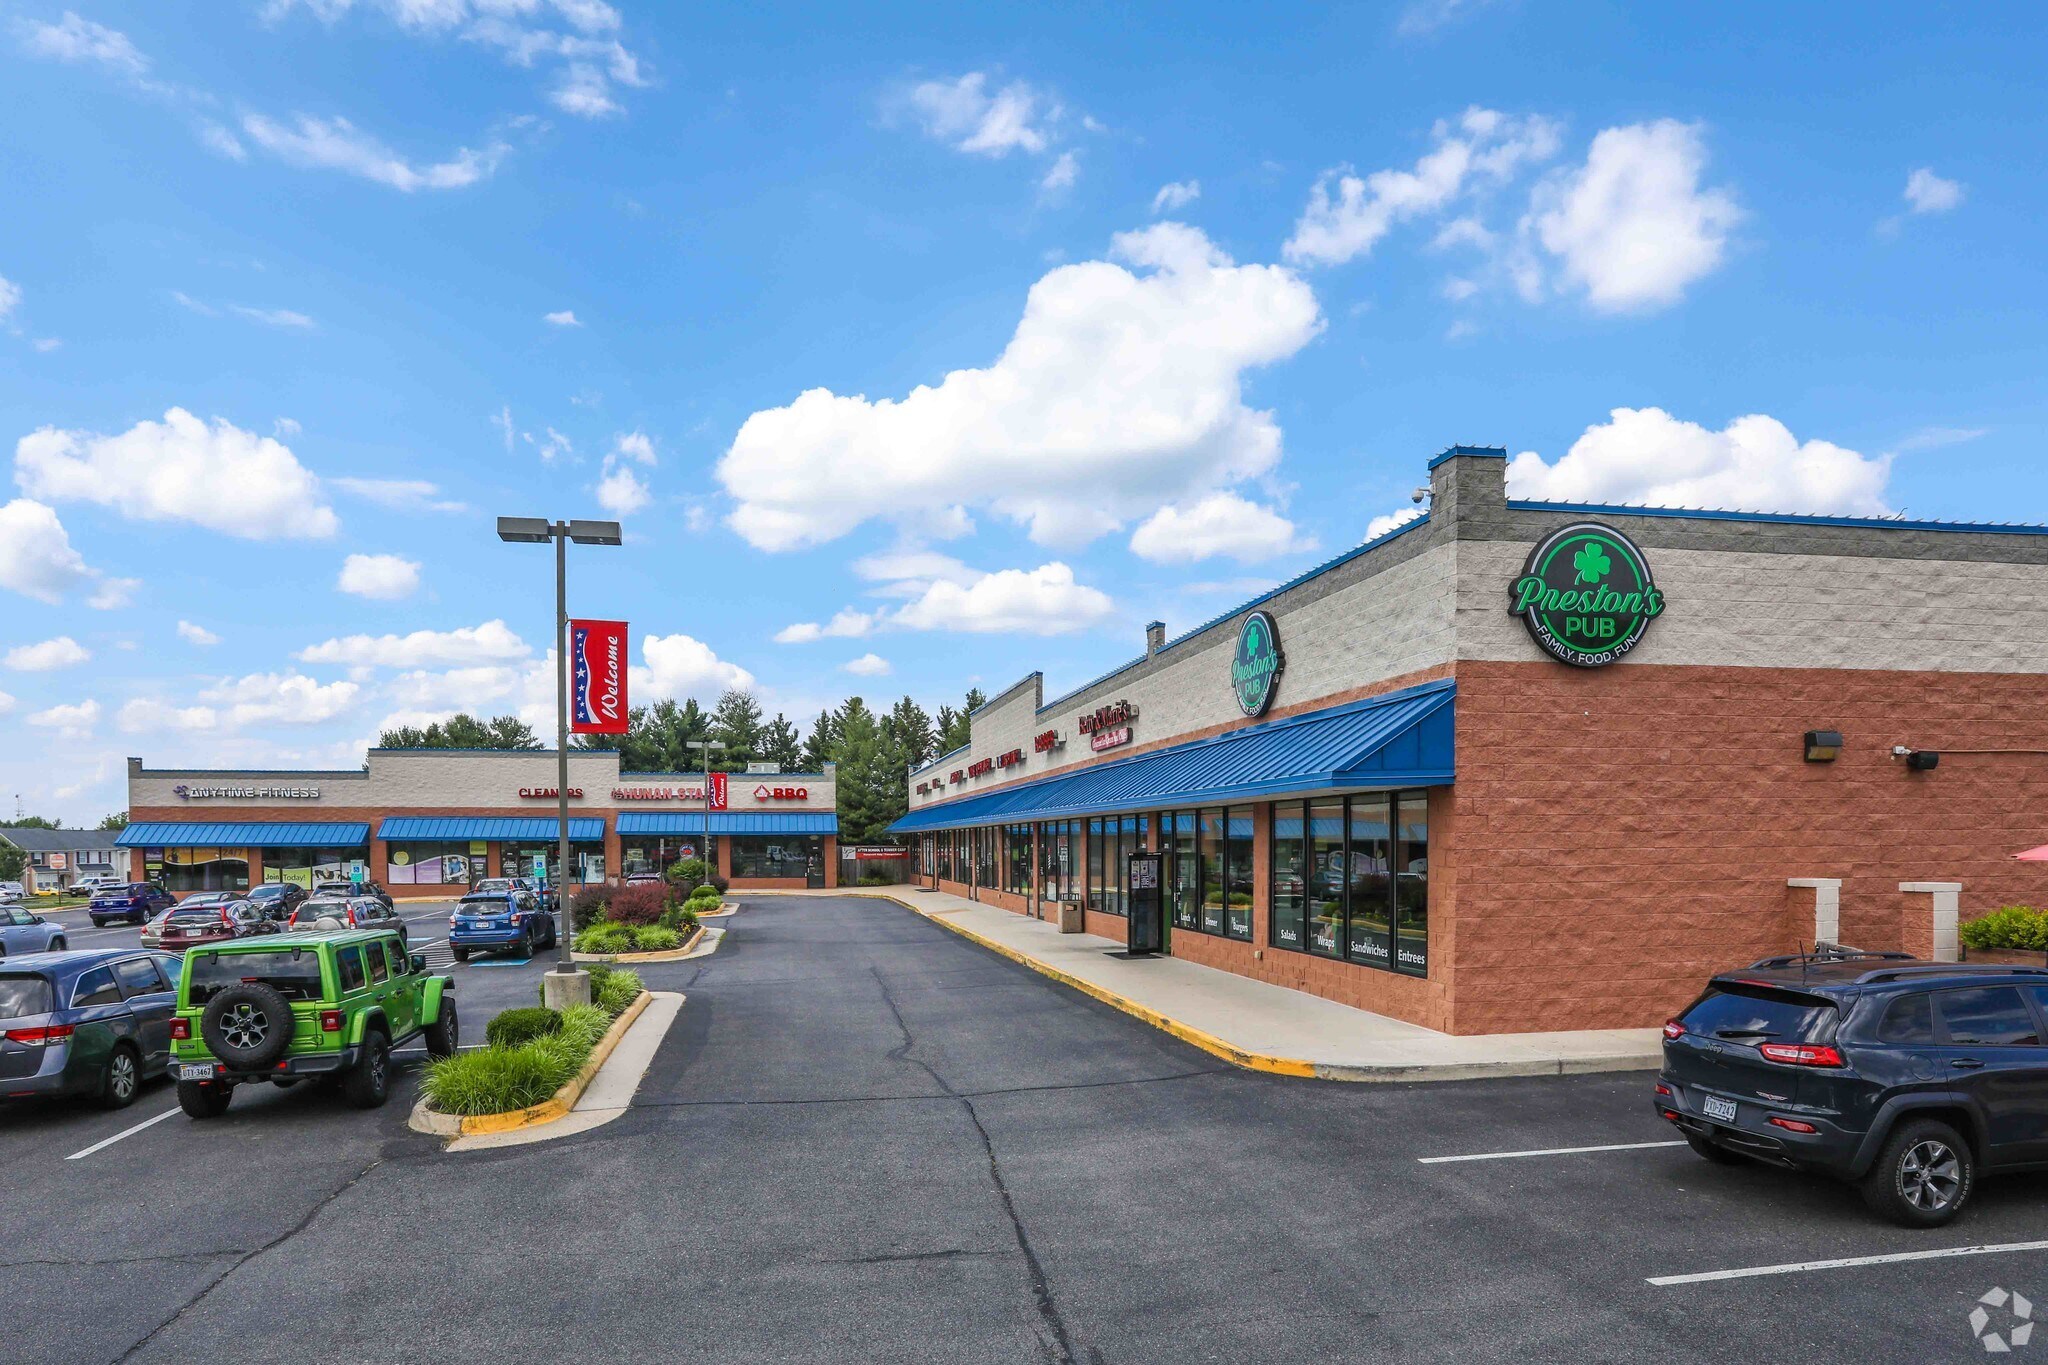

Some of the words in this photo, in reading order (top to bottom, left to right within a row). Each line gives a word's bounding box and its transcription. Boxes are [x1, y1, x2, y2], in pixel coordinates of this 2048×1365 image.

[1517, 576, 1663, 615] Preston's
[1566, 616, 1616, 638] PUB
[1615, 634, 1637, 657] FUN
[1232, 649, 1277, 682] Preston's
[601, 635, 618, 720] Welcome
[1245, 678, 1260, 698] PUB
[518, 787, 584, 799] CLEANRS
[623, 787, 673, 800] HUNAN
[677, 787, 705, 800] STA
[773, 788, 808, 800] BBQ
[222, 847, 243, 856] 24/7
[283, 874, 306, 882] Today!
[1180, 912, 1191, 922] Lunch
[1205, 917, 1218, 927] Dinner
[1232, 921, 1249, 934] Burgers
[1280, 929, 1297, 941] Salads
[1317, 935, 1335, 951] Wraps
[1351, 941, 1389, 958] Sandwiches
[1398, 949, 1426, 965] Entrees
[1705, 1043, 1723, 1054] Jeep
